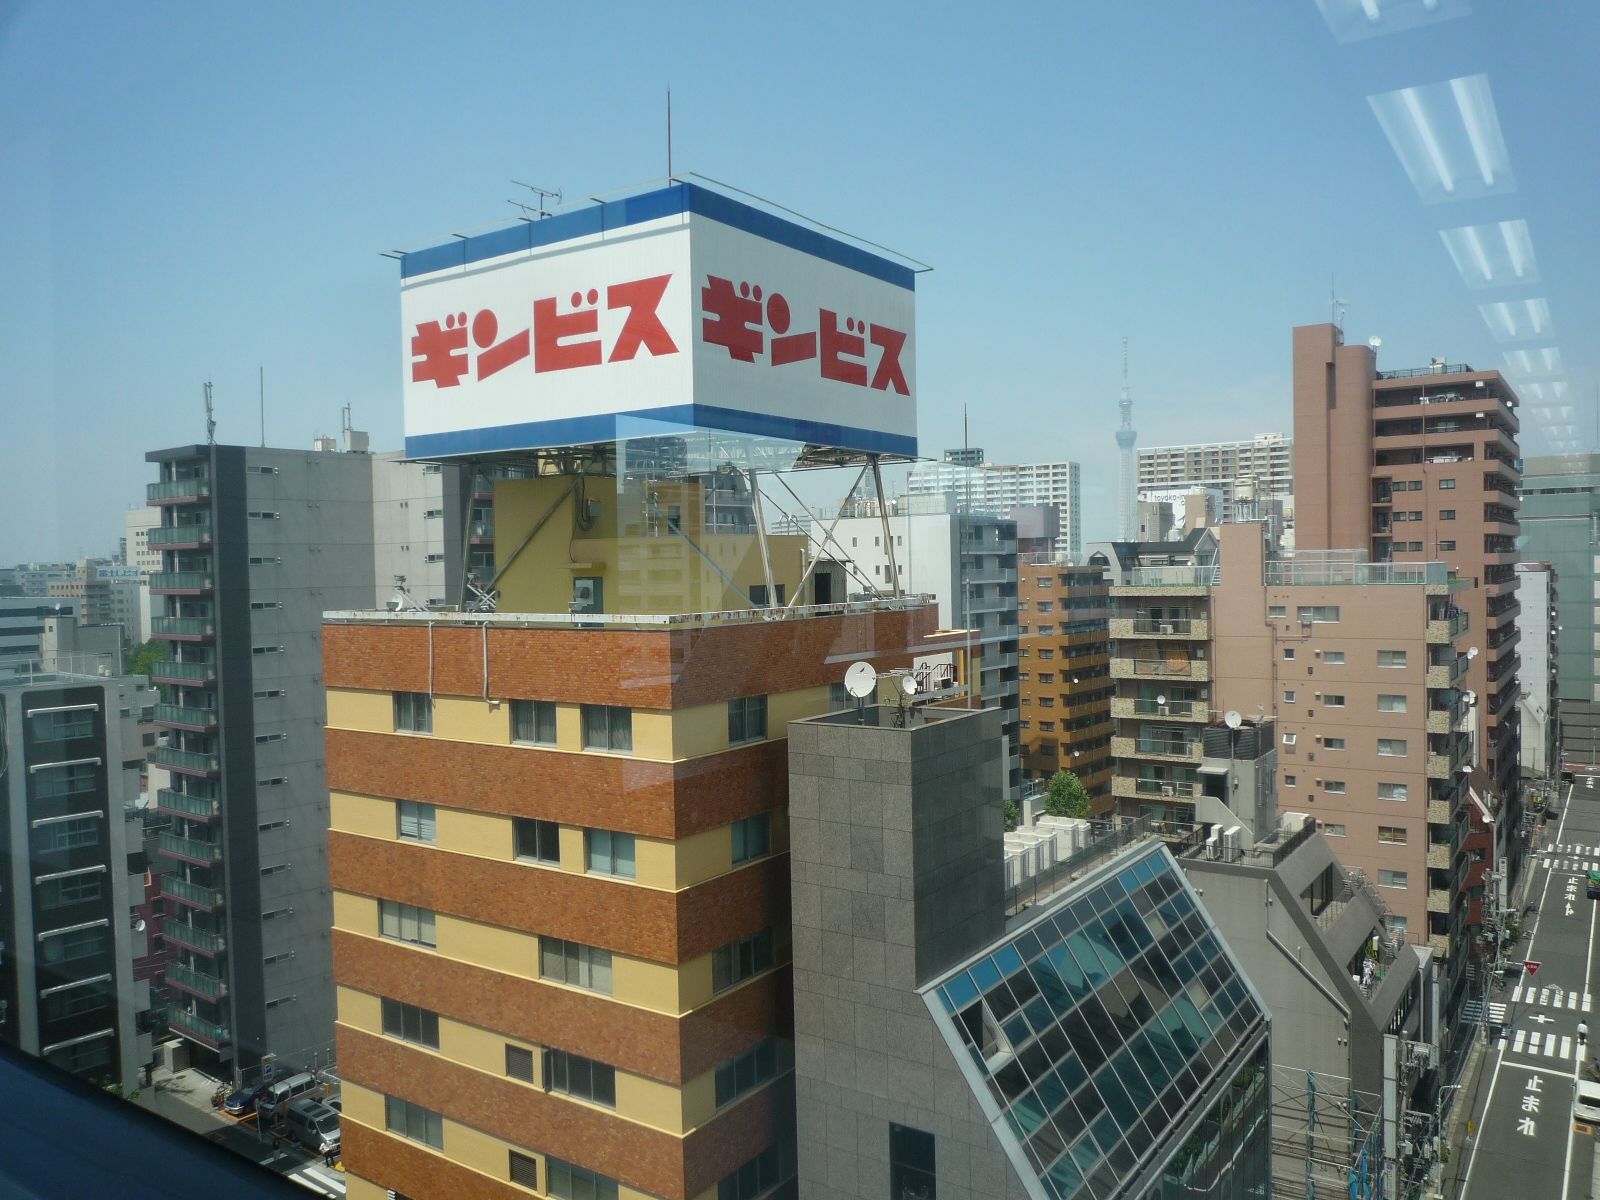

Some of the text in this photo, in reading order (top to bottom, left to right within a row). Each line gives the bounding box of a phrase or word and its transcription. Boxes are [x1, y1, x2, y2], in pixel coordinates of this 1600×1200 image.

[411, 273, 680, 389] ギンビス
[701, 273, 911, 396] ギンビス
[1564, 877, 1578, 901] 止まれ
[1516, 1075, 1544, 1136] 止まれ
